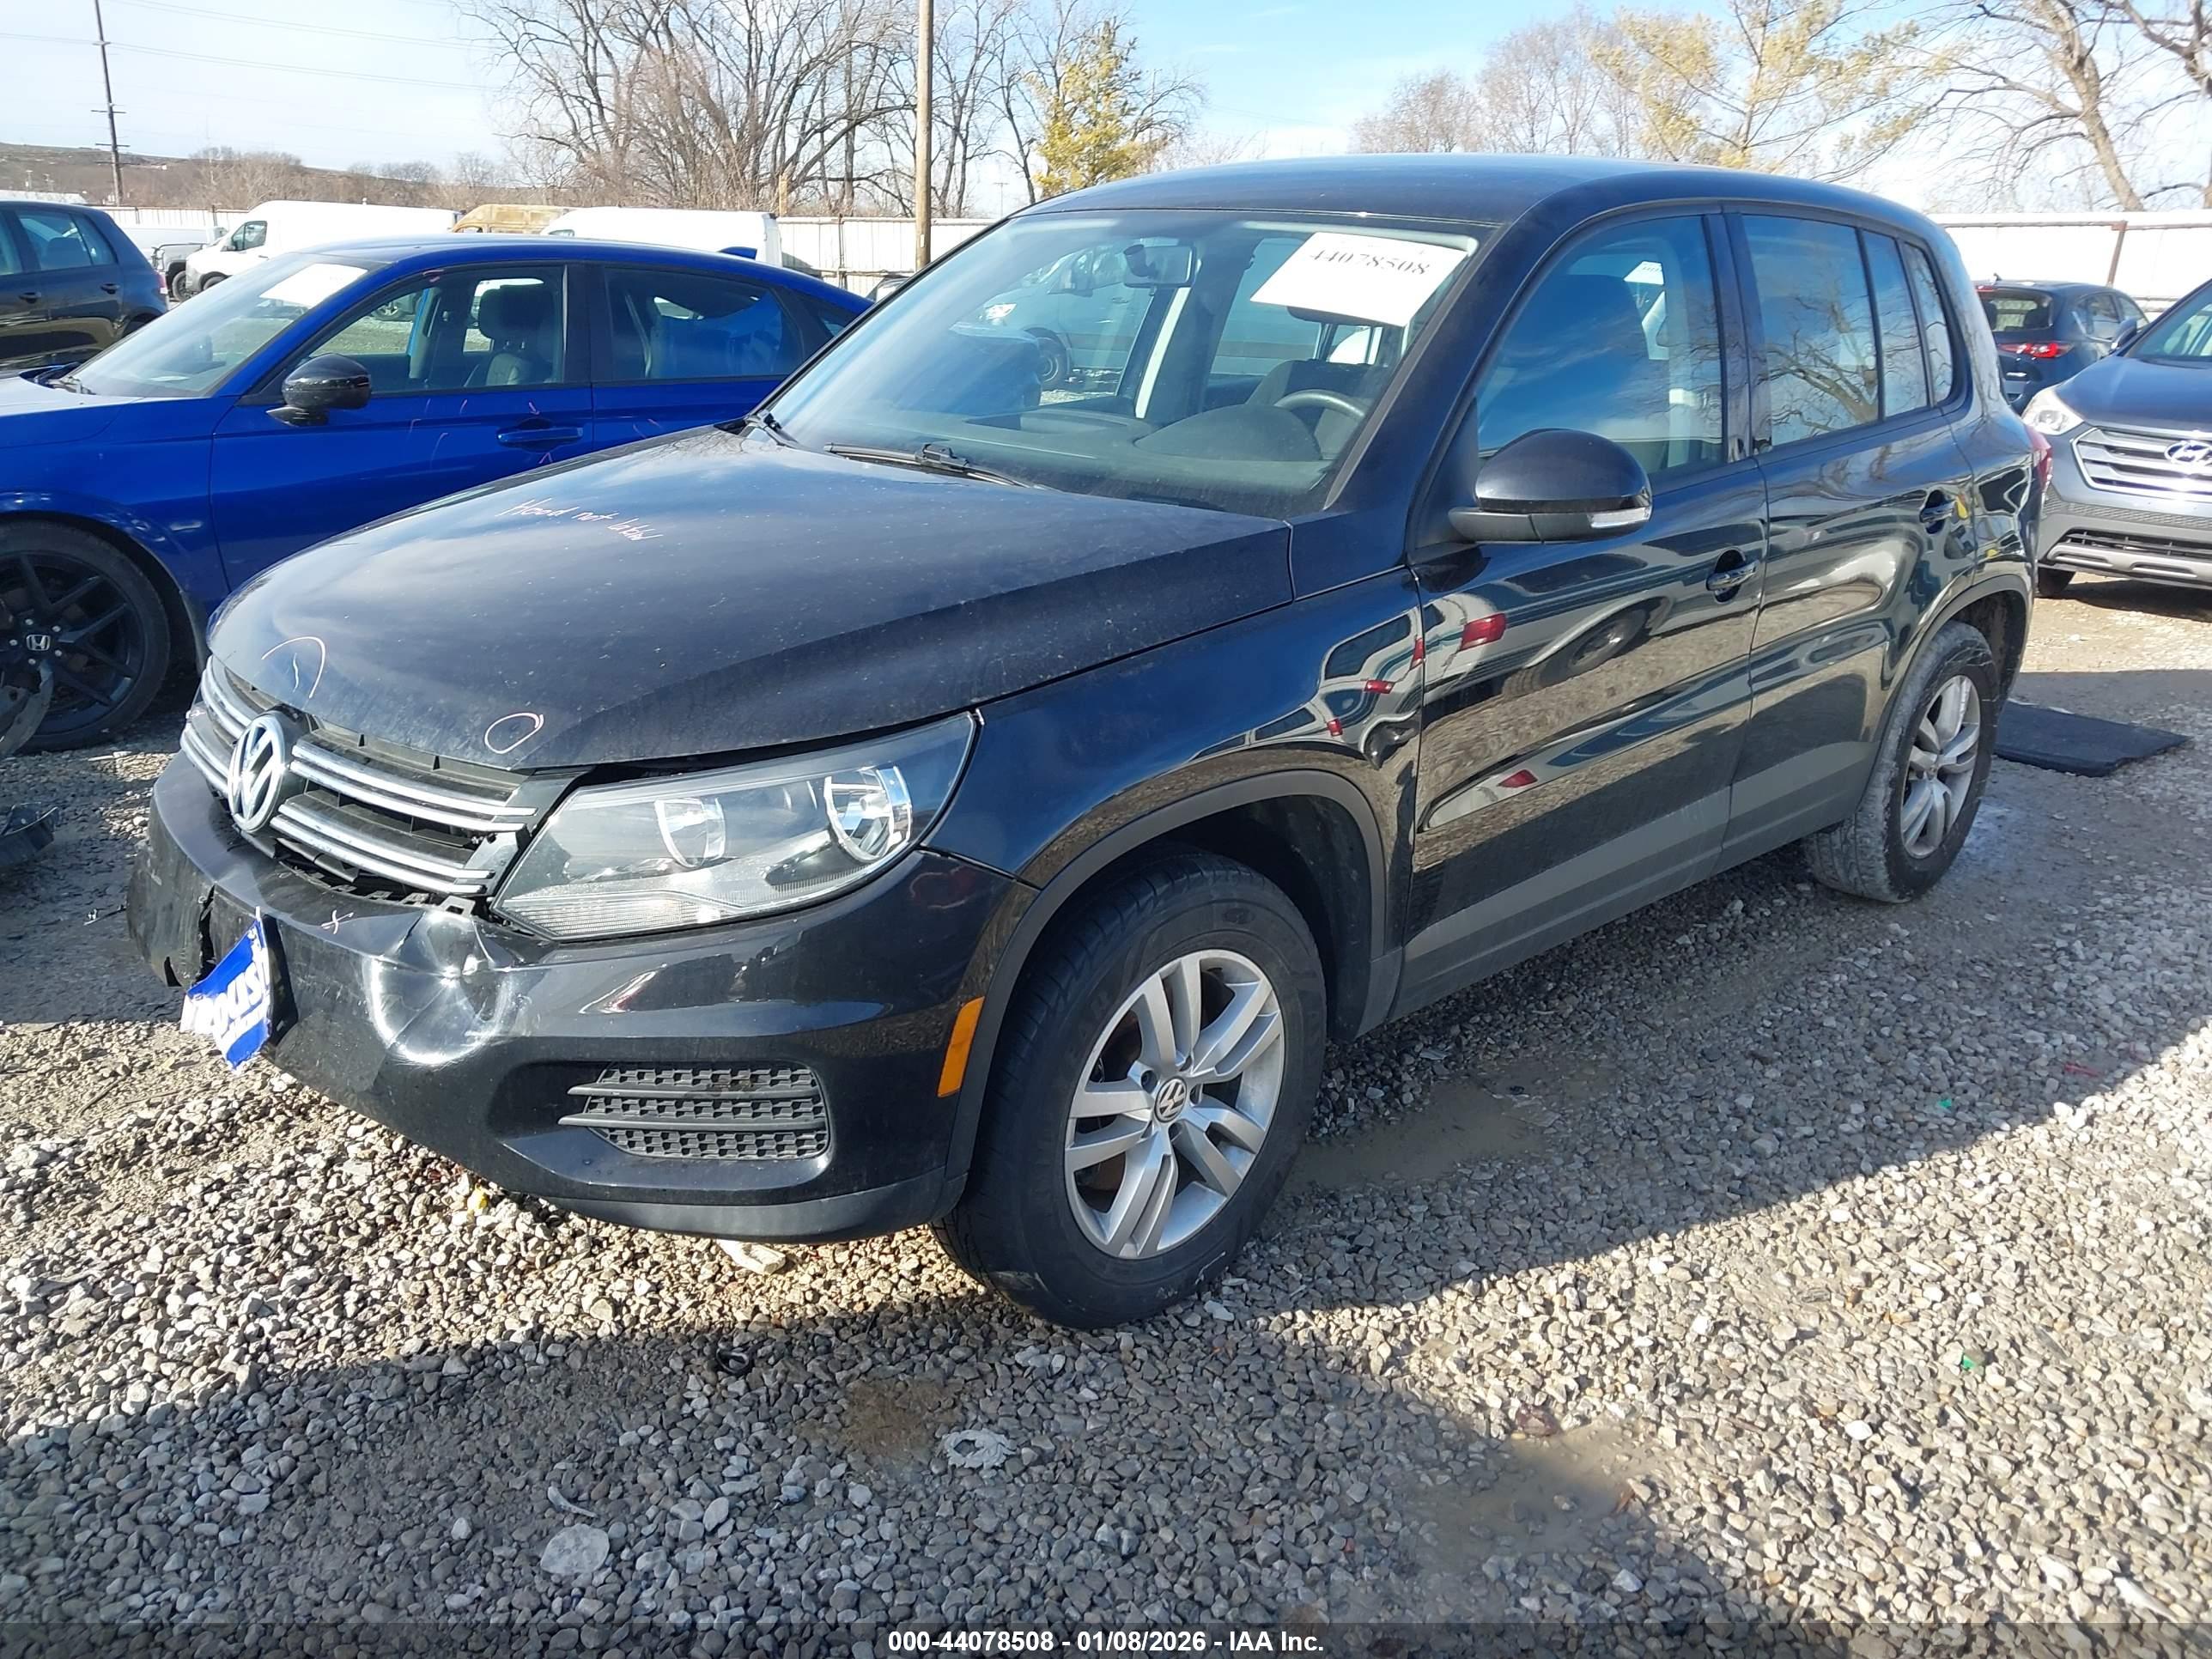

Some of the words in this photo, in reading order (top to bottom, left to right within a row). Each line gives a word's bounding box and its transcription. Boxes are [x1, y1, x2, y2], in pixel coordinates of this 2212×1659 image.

[1309, 248, 1431, 276] 44078508
[495, 497, 580, 517] Hood
[571, 510, 620, 522] not
